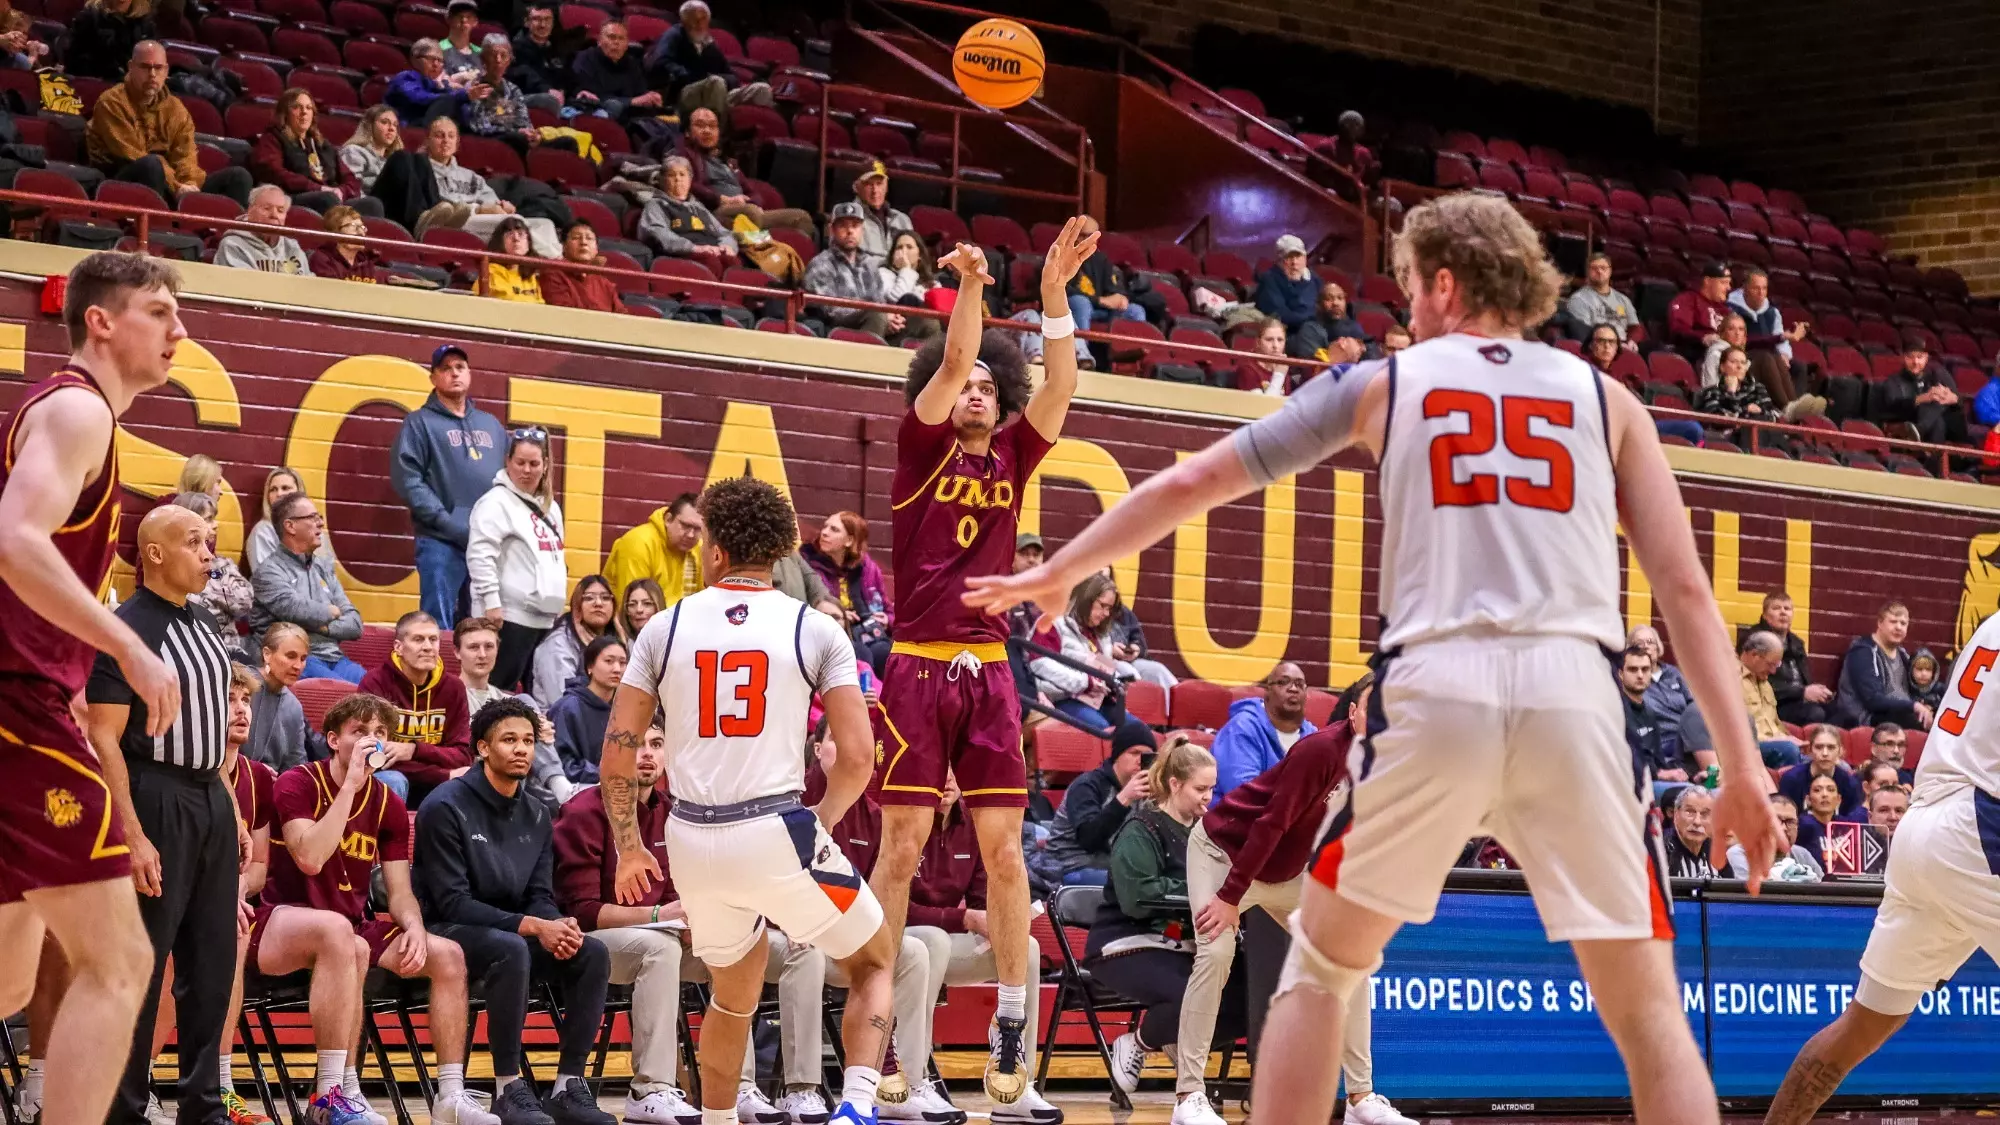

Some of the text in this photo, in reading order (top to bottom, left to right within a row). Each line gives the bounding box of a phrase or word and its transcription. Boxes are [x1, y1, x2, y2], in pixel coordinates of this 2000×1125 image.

[963, 52, 1021, 75] Wilson
[1423, 388, 1574, 514] 25
[935, 475, 1013, 509] UMD
[956, 515, 979, 548] 0
[695, 650, 769, 738] 13
[1938, 646, 2000, 736] 5
[1542, 980, 1560, 1012] &
[1957, 986, 2000, 1016] THE
[1491, 1103, 1535, 1111] DAKTRONICS
